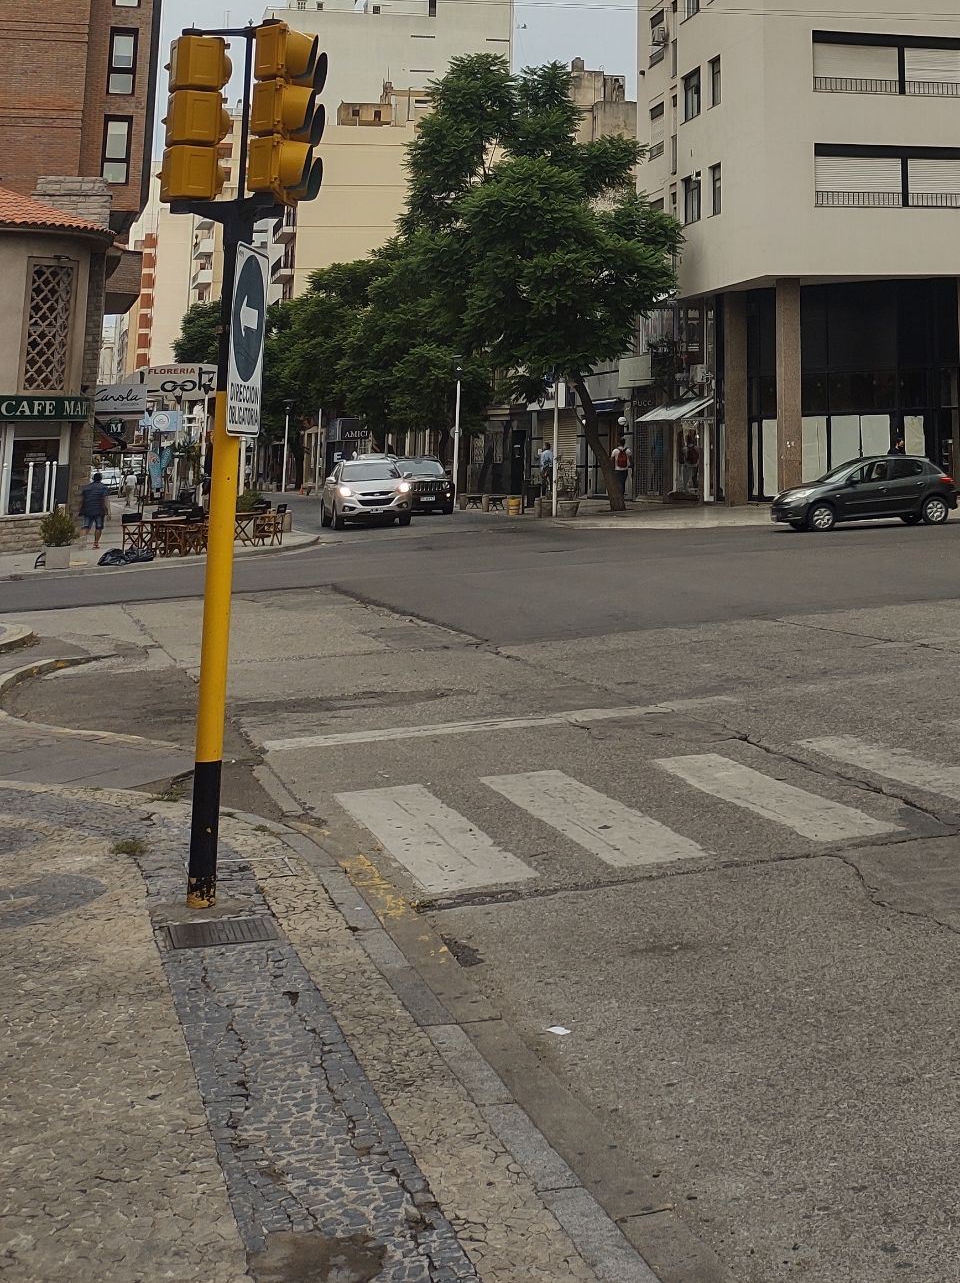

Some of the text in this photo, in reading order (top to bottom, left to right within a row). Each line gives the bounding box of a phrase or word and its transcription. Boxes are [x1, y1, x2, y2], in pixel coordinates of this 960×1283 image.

[95, 388, 143, 402] Carola
[230, 383, 259, 405] DIRECCION
[1, 400, 56, 416] CAFE
[229, 404, 258, 426] OBLIGATORIA
[110, 423, 121, 433] M
